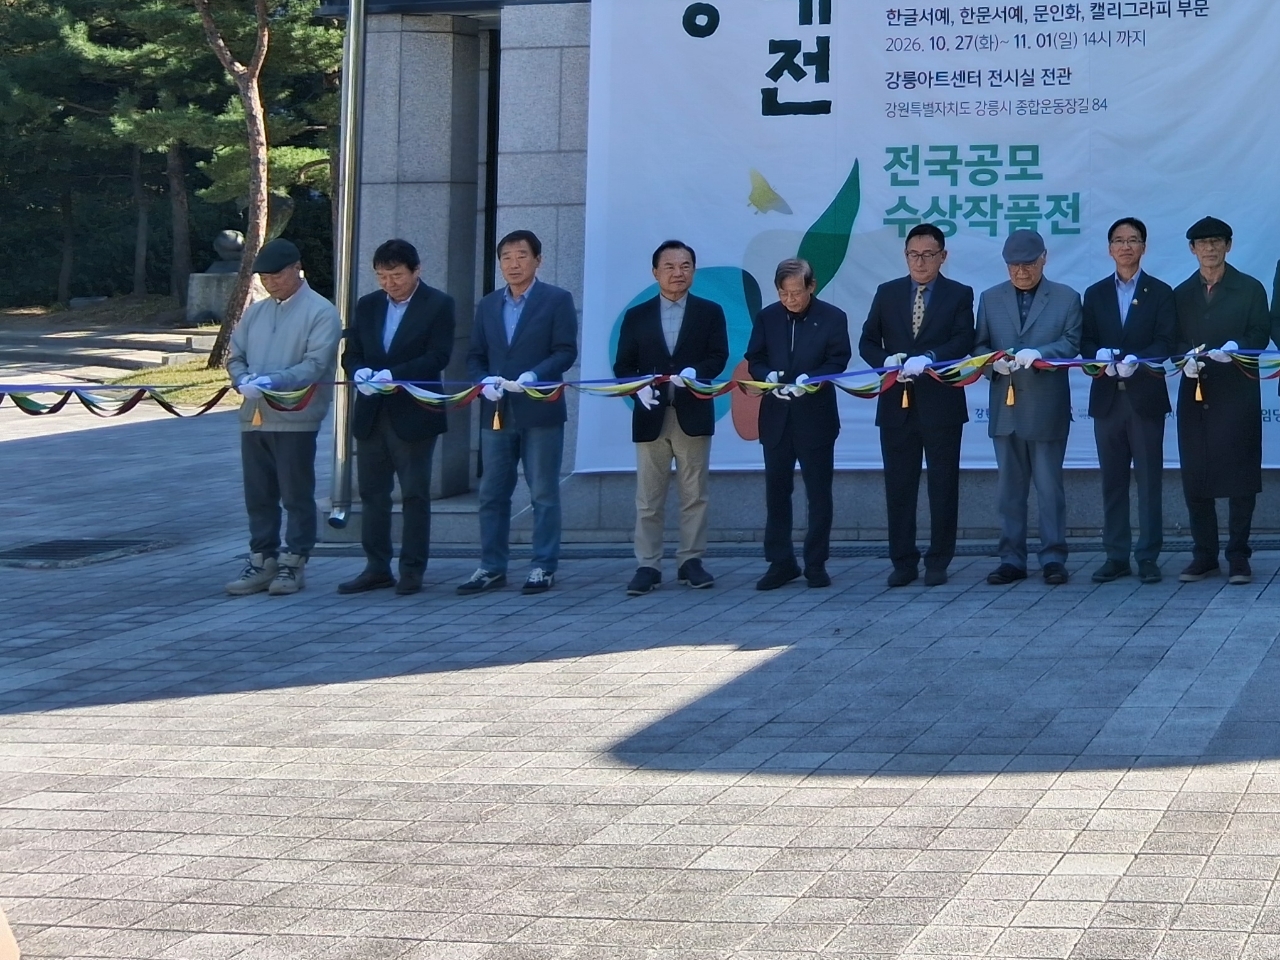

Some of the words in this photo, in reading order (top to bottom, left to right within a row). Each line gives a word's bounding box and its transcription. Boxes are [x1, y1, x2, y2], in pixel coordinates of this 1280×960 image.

[886, 7, 955, 26] 한글서예,
[959, 5, 1028, 25] 한문서예,
[1033, 3, 1085, 22] 문인화,
[1090, 0, 1171, 20] 캘리그라피
[1177, 0, 1209, 18] 부문
[886, 37, 925, 52] 2026.
[929, 35, 950, 51] 10.
[1014, 33, 1031, 49] 11.
[1036, 31, 1078, 50] 01(일)
[1083, 30, 1111, 47] 14시
[1116, 29, 1146, 47] 까지
[885, 69, 982, 90] 강릉아트센터
[987, 68, 1035, 87] 전시실
[1041, 67, 1072, 86] 전관
[885, 101, 971, 118] 강원특별자치도
[974, 100, 1012, 116] 강릉시
[1015, 97, 1089, 115] 종합운동장길
[1092, 97, 1108, 112] 84
[883, 144, 1043, 187] 전국공모
[883, 192, 1081, 238] 수상작품전
